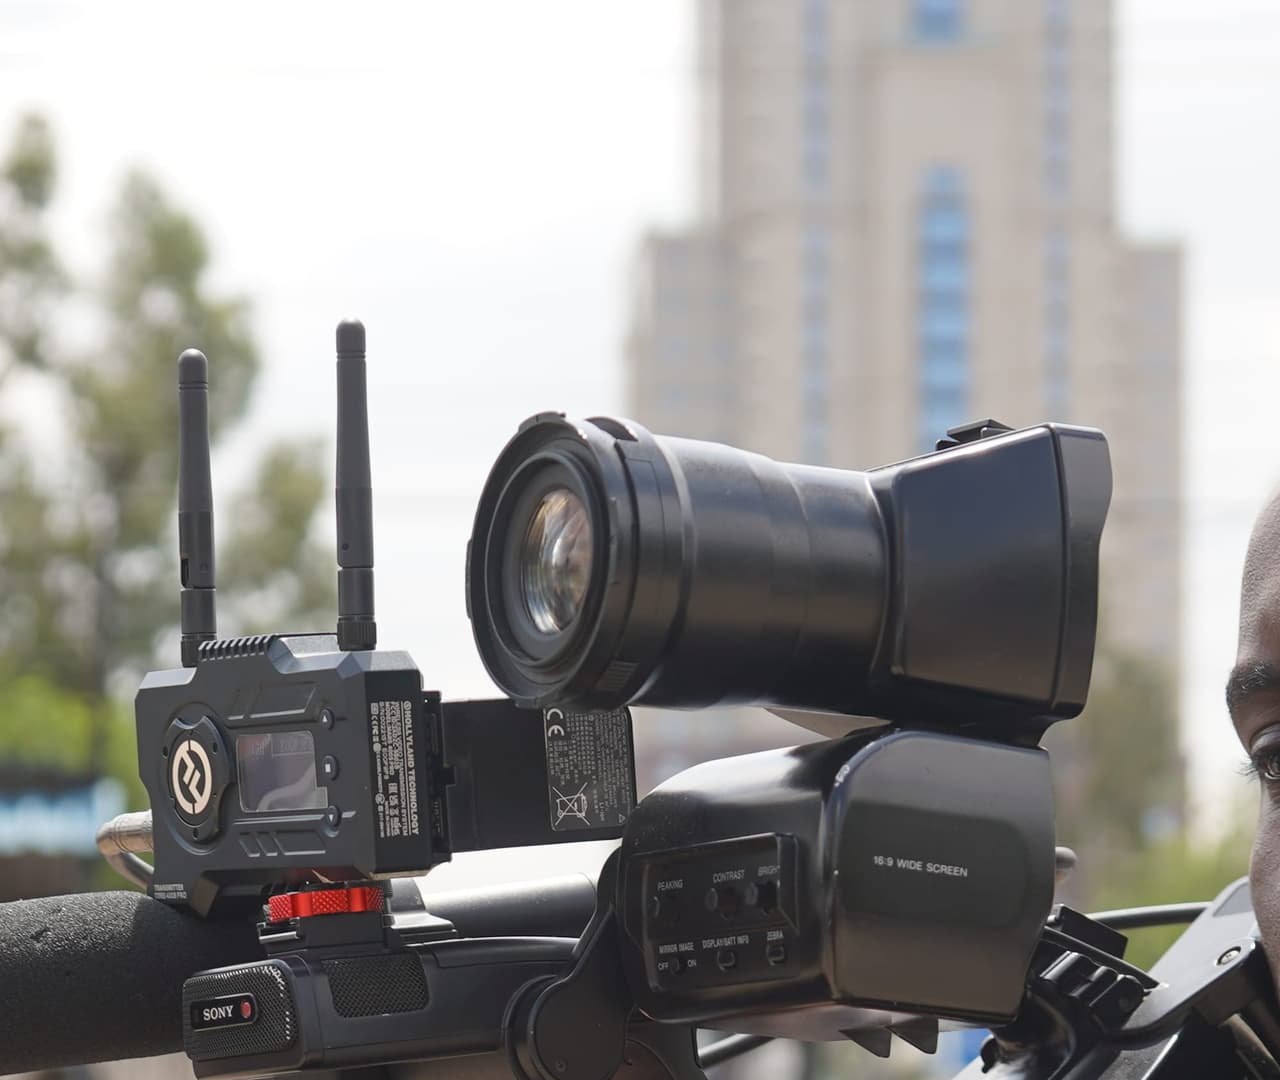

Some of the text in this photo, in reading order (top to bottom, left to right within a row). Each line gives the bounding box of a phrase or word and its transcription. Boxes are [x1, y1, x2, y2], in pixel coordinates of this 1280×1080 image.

[404, 711, 419, 835] HOLLYLAND TECHNOLOGY
[873, 855, 968, 878] 16:9 WIDE SCREEN
[713, 869, 745, 883] CONTRAST
[657, 879, 684, 891] PEAKING
[766, 930, 784, 941] ZEBRA
[659, 942, 696, 954] MIRROR IMAGE
[657, 959, 697, 971] OFF ON
[203, 1005, 234, 1021] SONY
